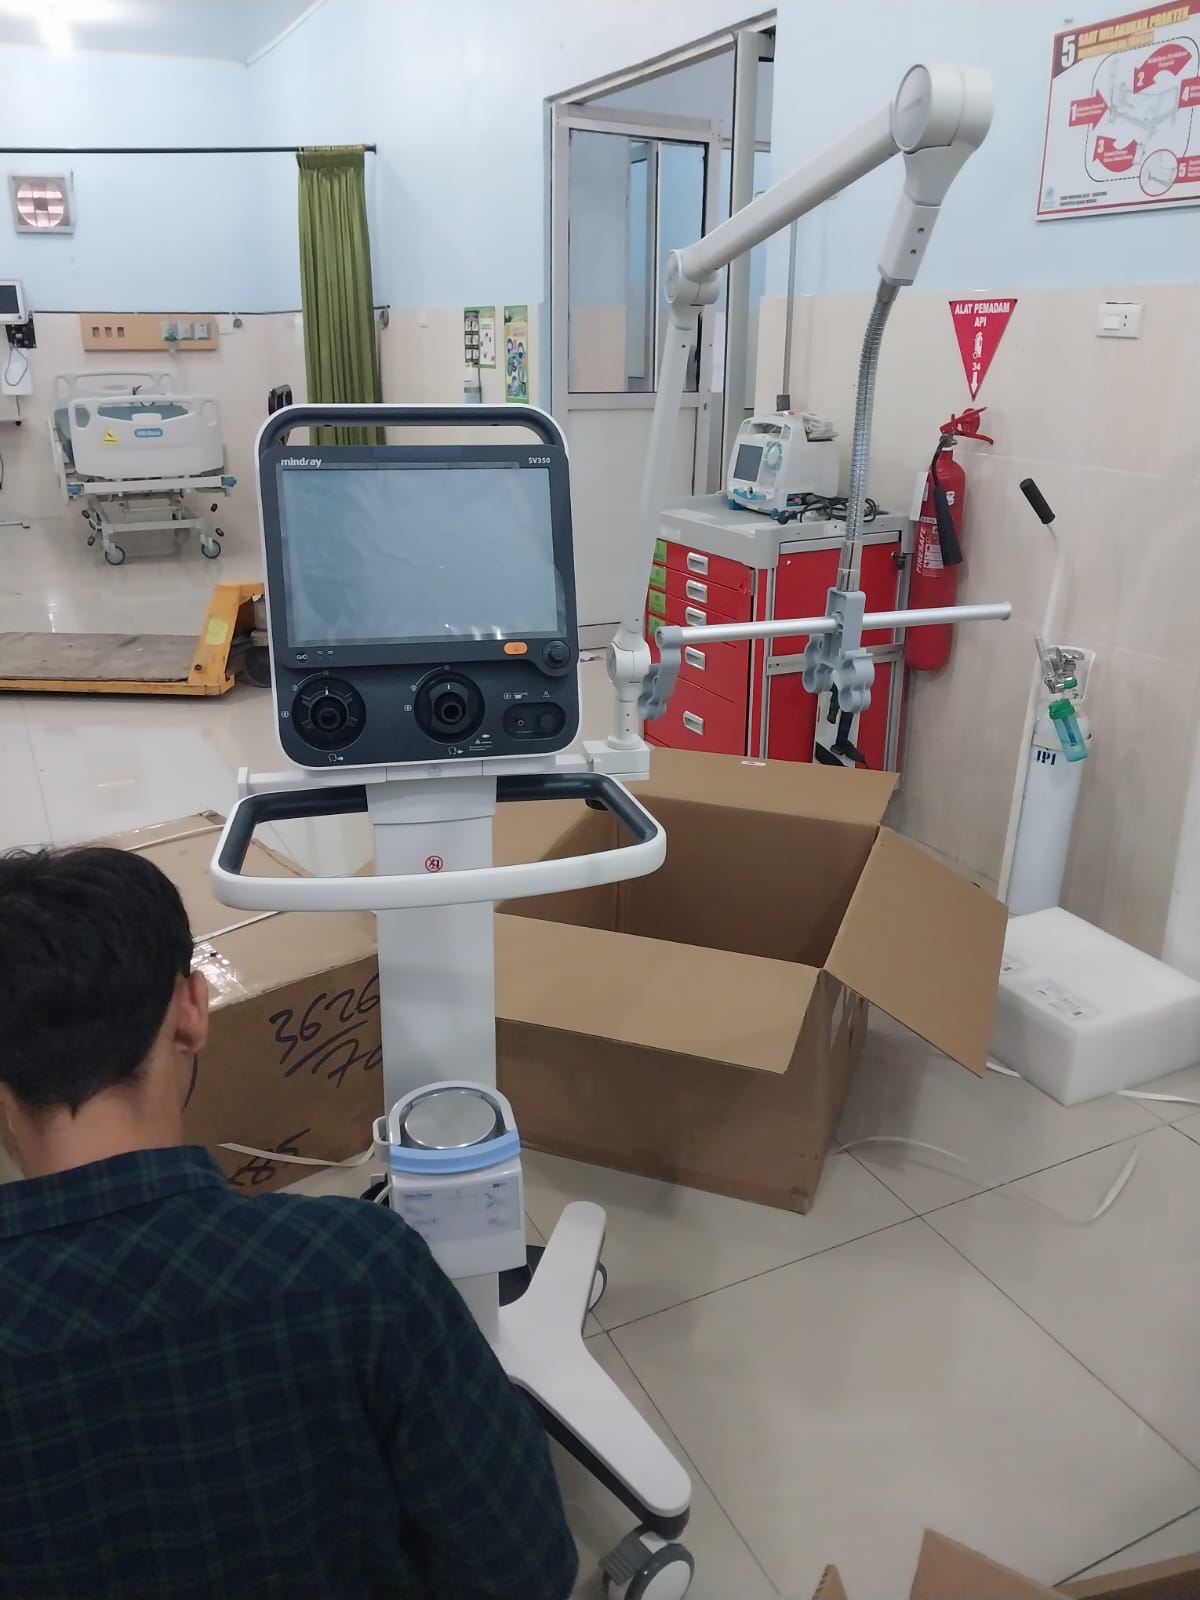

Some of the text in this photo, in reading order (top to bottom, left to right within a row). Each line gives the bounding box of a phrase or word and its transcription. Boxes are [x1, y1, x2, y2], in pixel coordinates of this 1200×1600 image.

[1060, 33, 1076, 69] 5
[1136, 71, 1145, 87] 2
[1181, 86, 1190, 102] 4
[1071, 103, 1078, 122] 1
[1097, 139, 1105, 154] 3
[1178, 162, 1187, 178] 5
[954, 302, 1011, 315] ALAT PEMADAM
[973, 316, 987, 327] API
[280, 457, 322, 468] mindray
